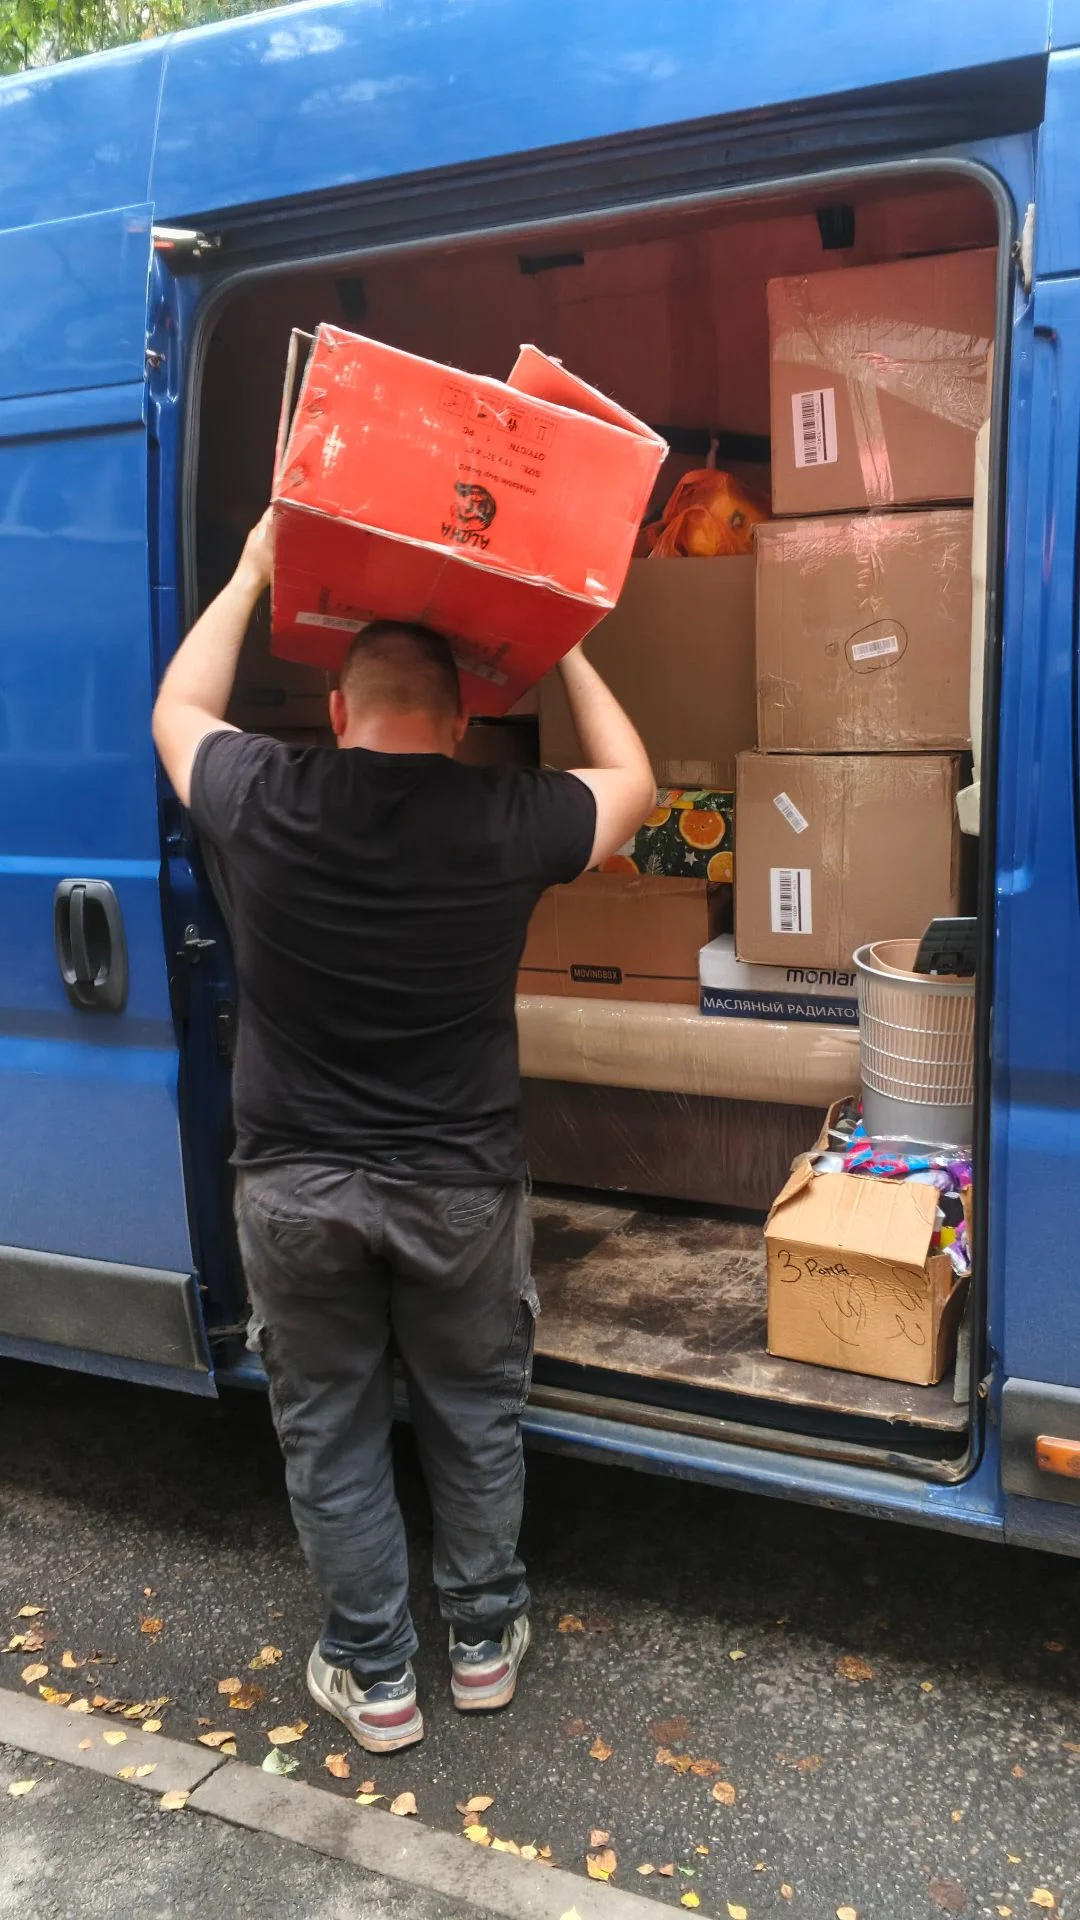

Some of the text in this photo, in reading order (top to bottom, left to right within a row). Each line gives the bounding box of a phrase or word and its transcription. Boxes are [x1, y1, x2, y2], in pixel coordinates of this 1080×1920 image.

[440, 521, 491, 550] ALOHA
[573, 967, 619, 980] MOVINGBOX
[702, 996, 860, 1019] МАСЛЯНЫЙ РАДИАТО
